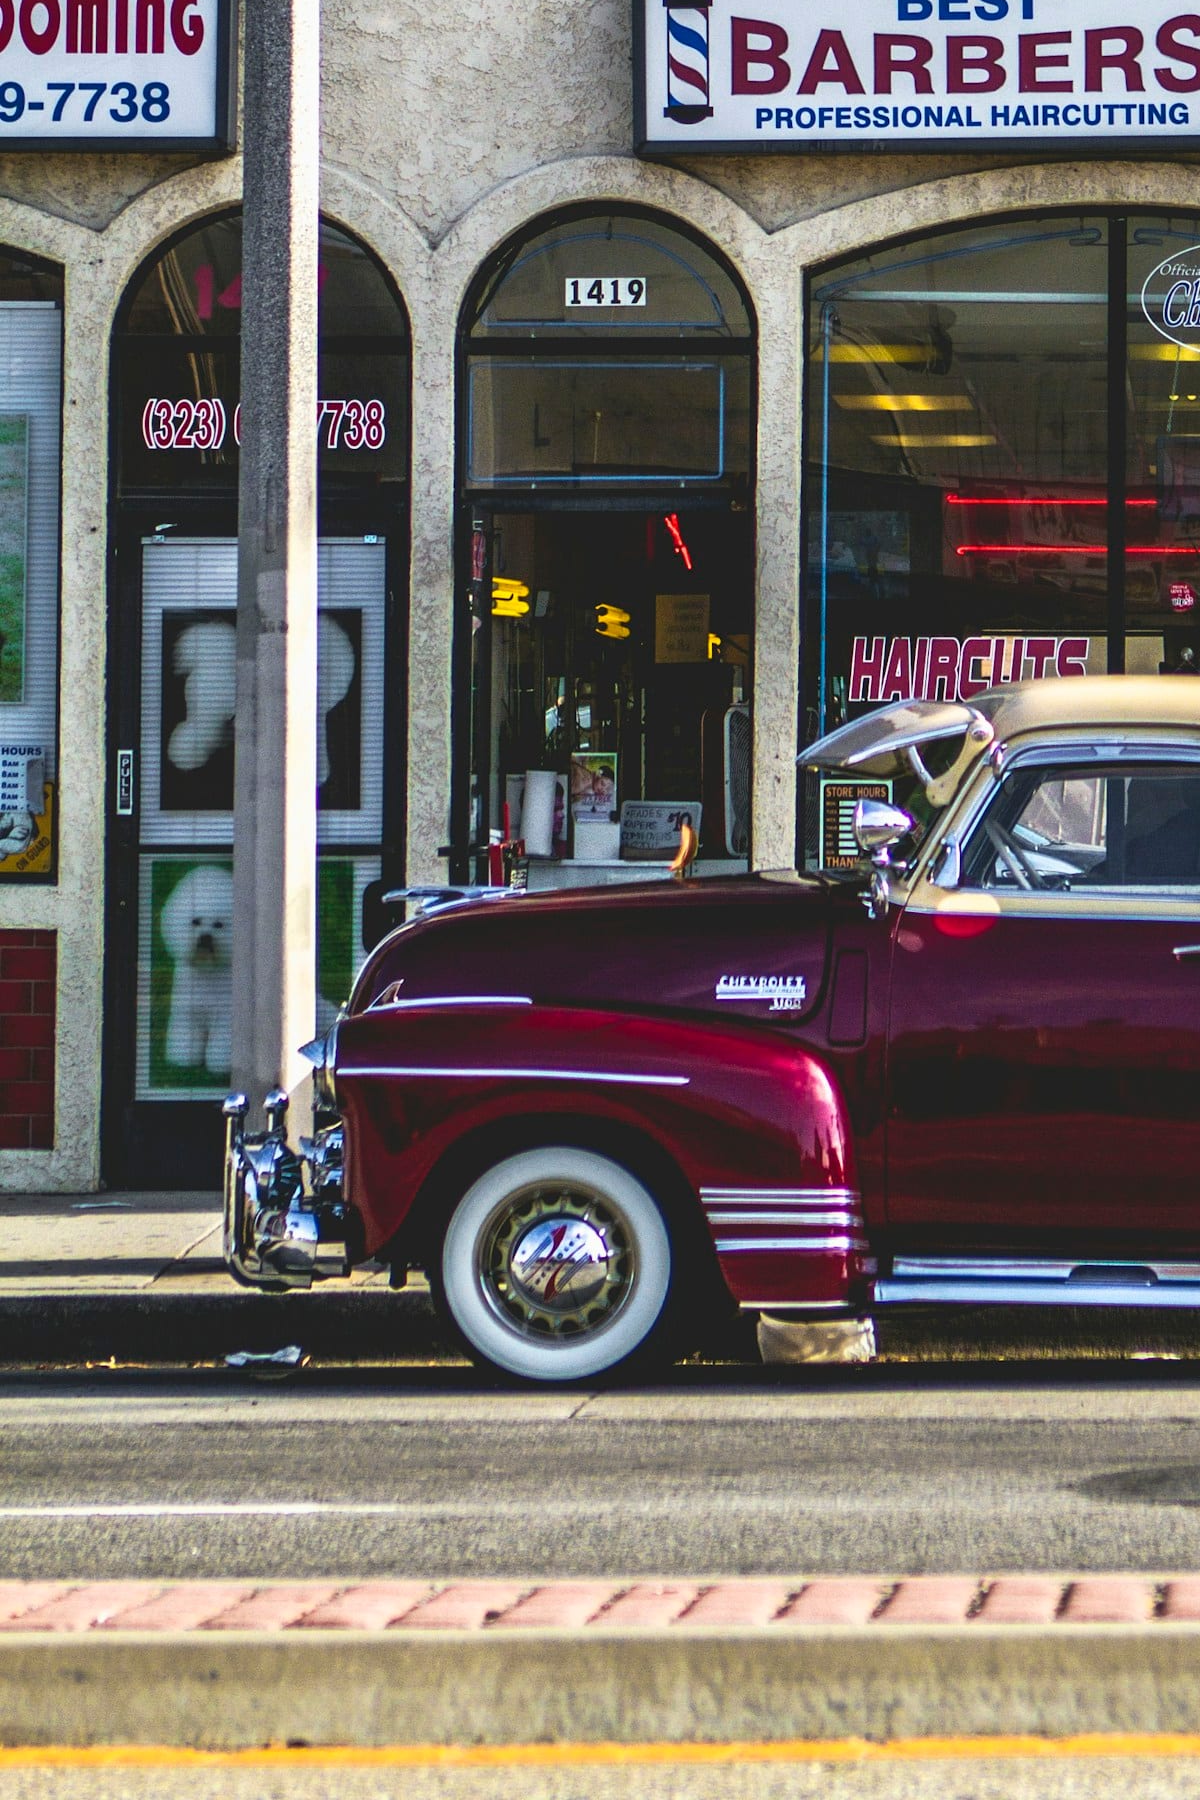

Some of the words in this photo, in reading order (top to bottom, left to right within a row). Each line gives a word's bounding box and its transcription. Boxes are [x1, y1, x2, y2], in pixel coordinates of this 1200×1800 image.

[755, 105, 983, 130] PROFESSIONAL
[990, 102, 1190, 128] HAIRCUTTING
[570, 279, 644, 305] 1419
[142, 398, 227, 450] (323)
[848, 635, 1090, 702] HAIRCUTS
[1, 747, 42, 756] HOURS
[121, 758, 130, 797] PULL
[825, 786, 854, 797] STORE
[857, 786, 887, 798] HOURS
[719, 974, 805, 988] CHEVROLET
